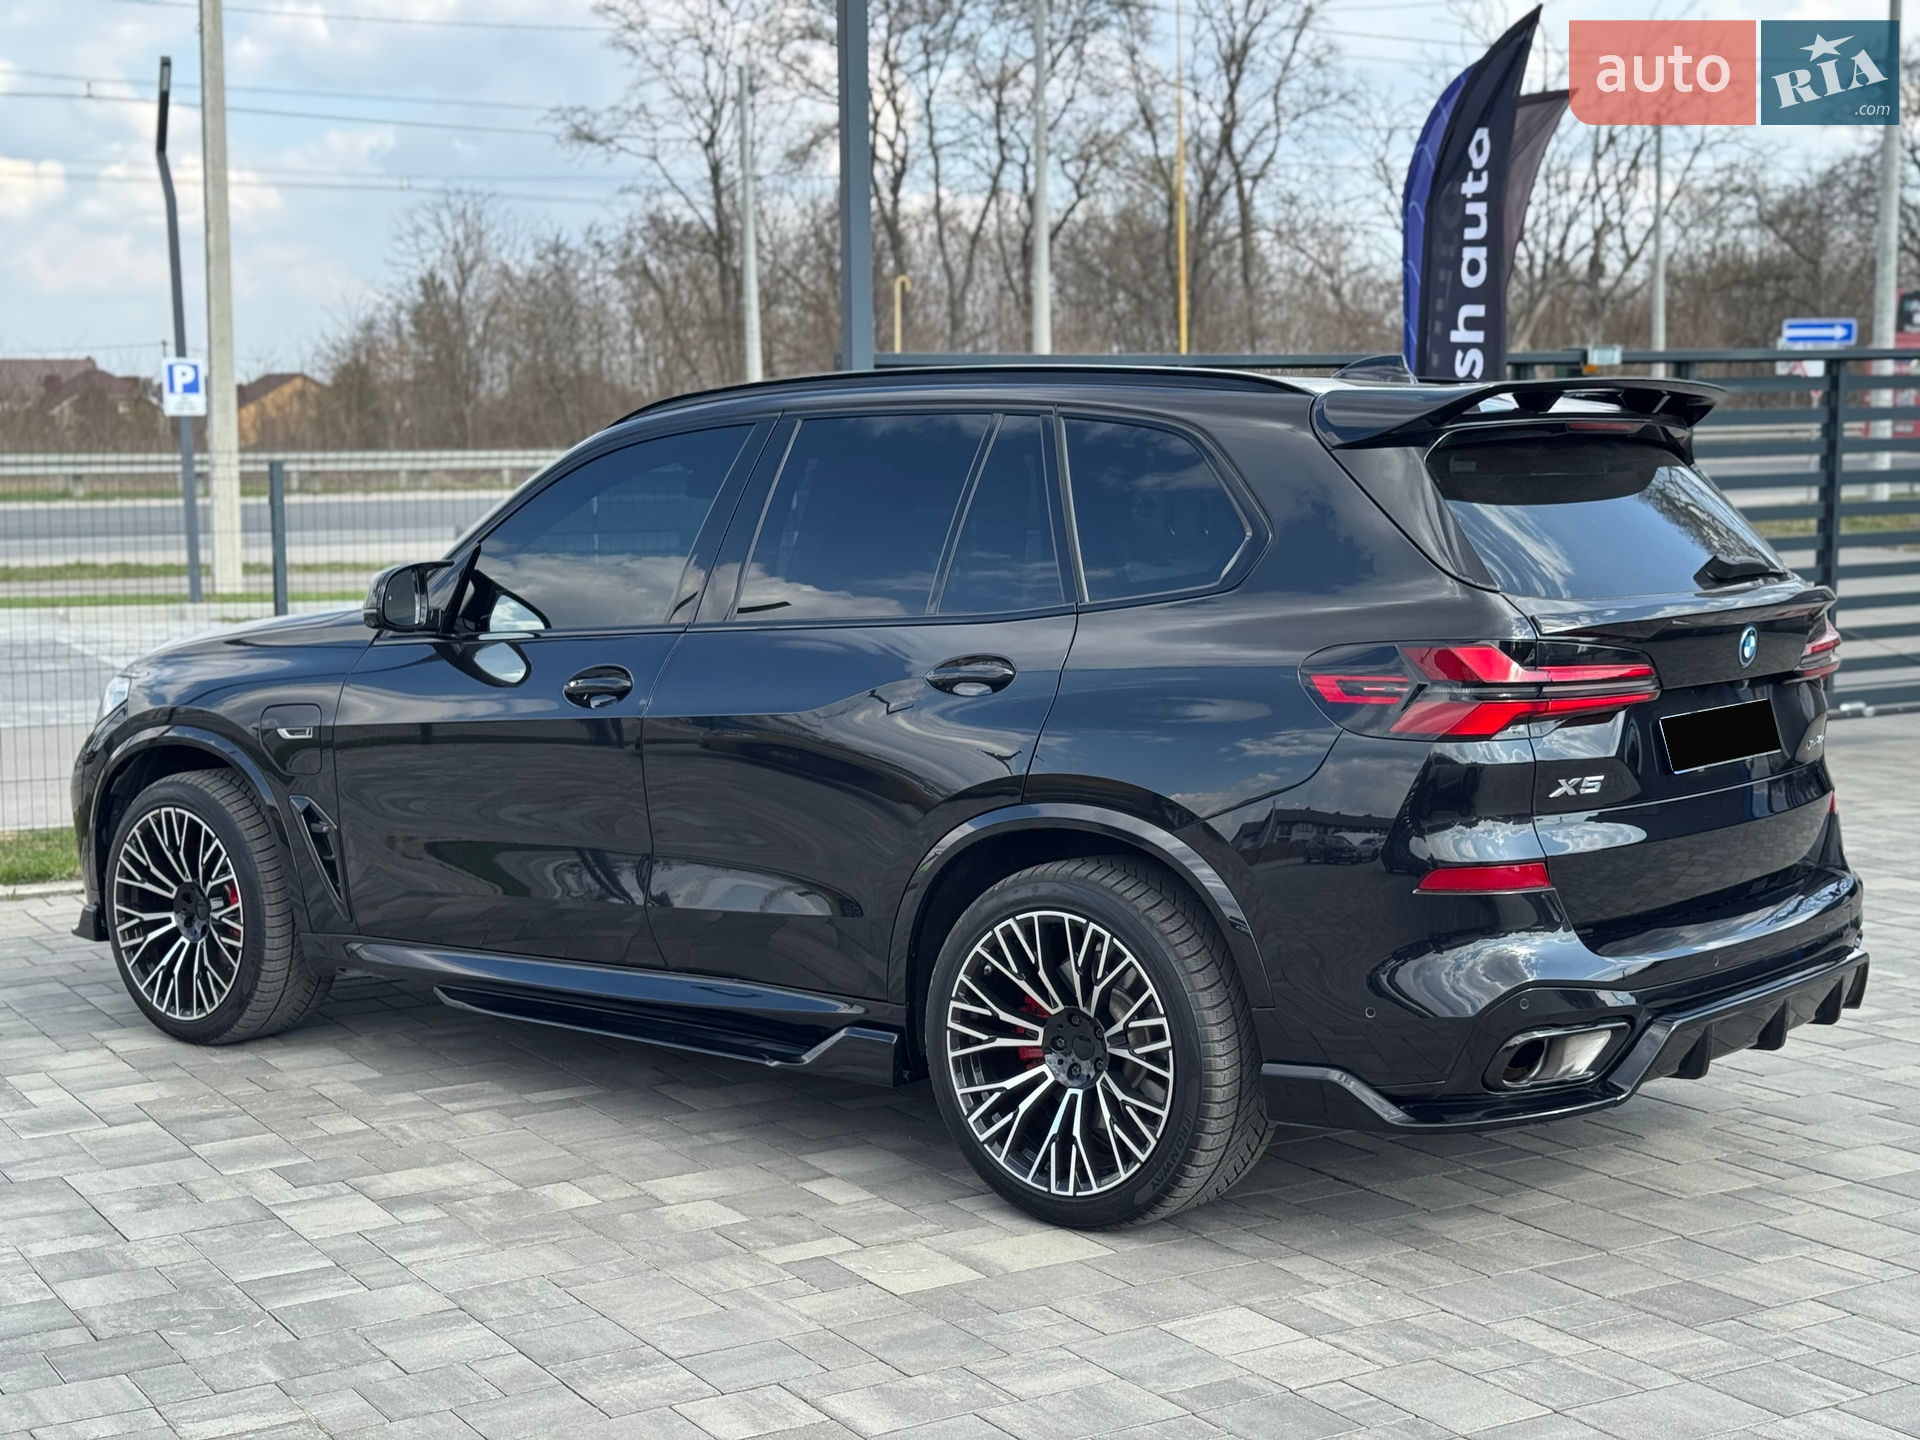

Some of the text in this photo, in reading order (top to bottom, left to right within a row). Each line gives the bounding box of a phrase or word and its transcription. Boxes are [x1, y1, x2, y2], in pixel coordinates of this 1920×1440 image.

[1460, 127, 1492, 289] auto
[173, 364, 196, 393] P
[1549, 775, 1605, 799] X5
